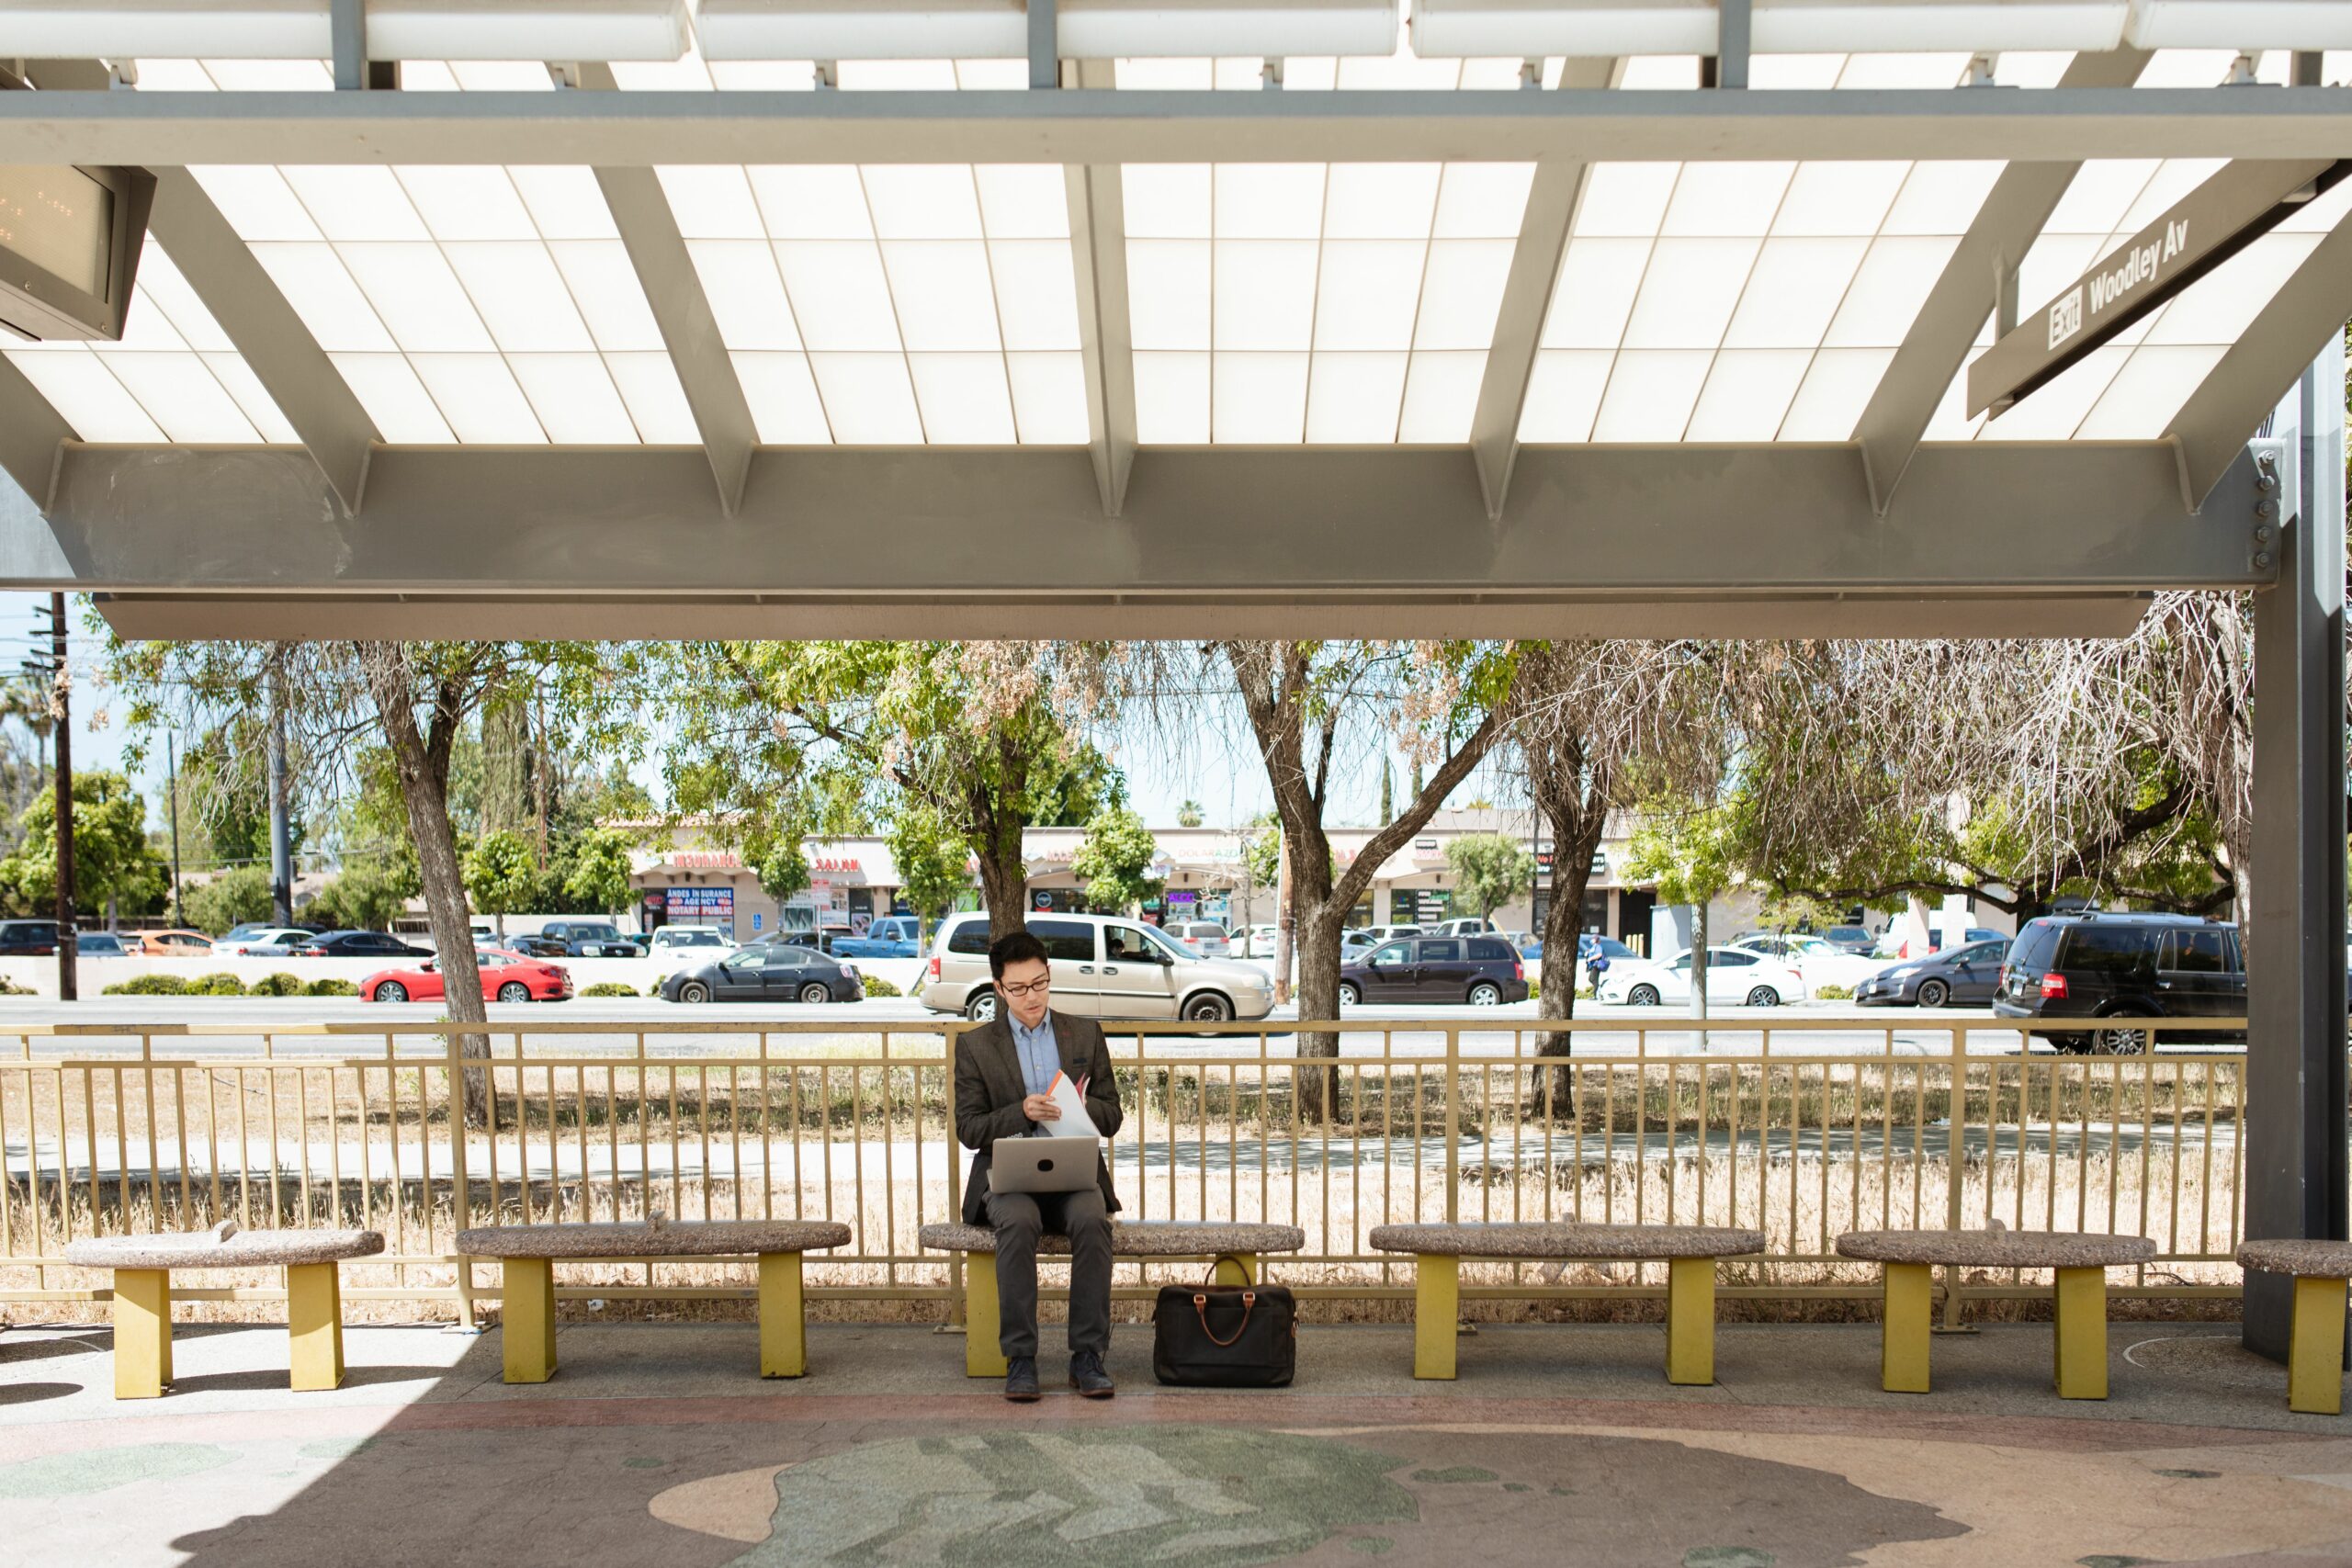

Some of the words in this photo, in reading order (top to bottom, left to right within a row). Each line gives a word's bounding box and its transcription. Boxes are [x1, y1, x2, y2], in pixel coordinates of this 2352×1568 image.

[2052, 293, 2079, 344] Exit
[2089, 239, 2162, 314] Woodley
[2162, 219, 2188, 264] Av
[667, 888, 690, 898] ANDES
[667, 906, 699, 915] NOTARY
[702, 906, 733, 915] PUBLIC
